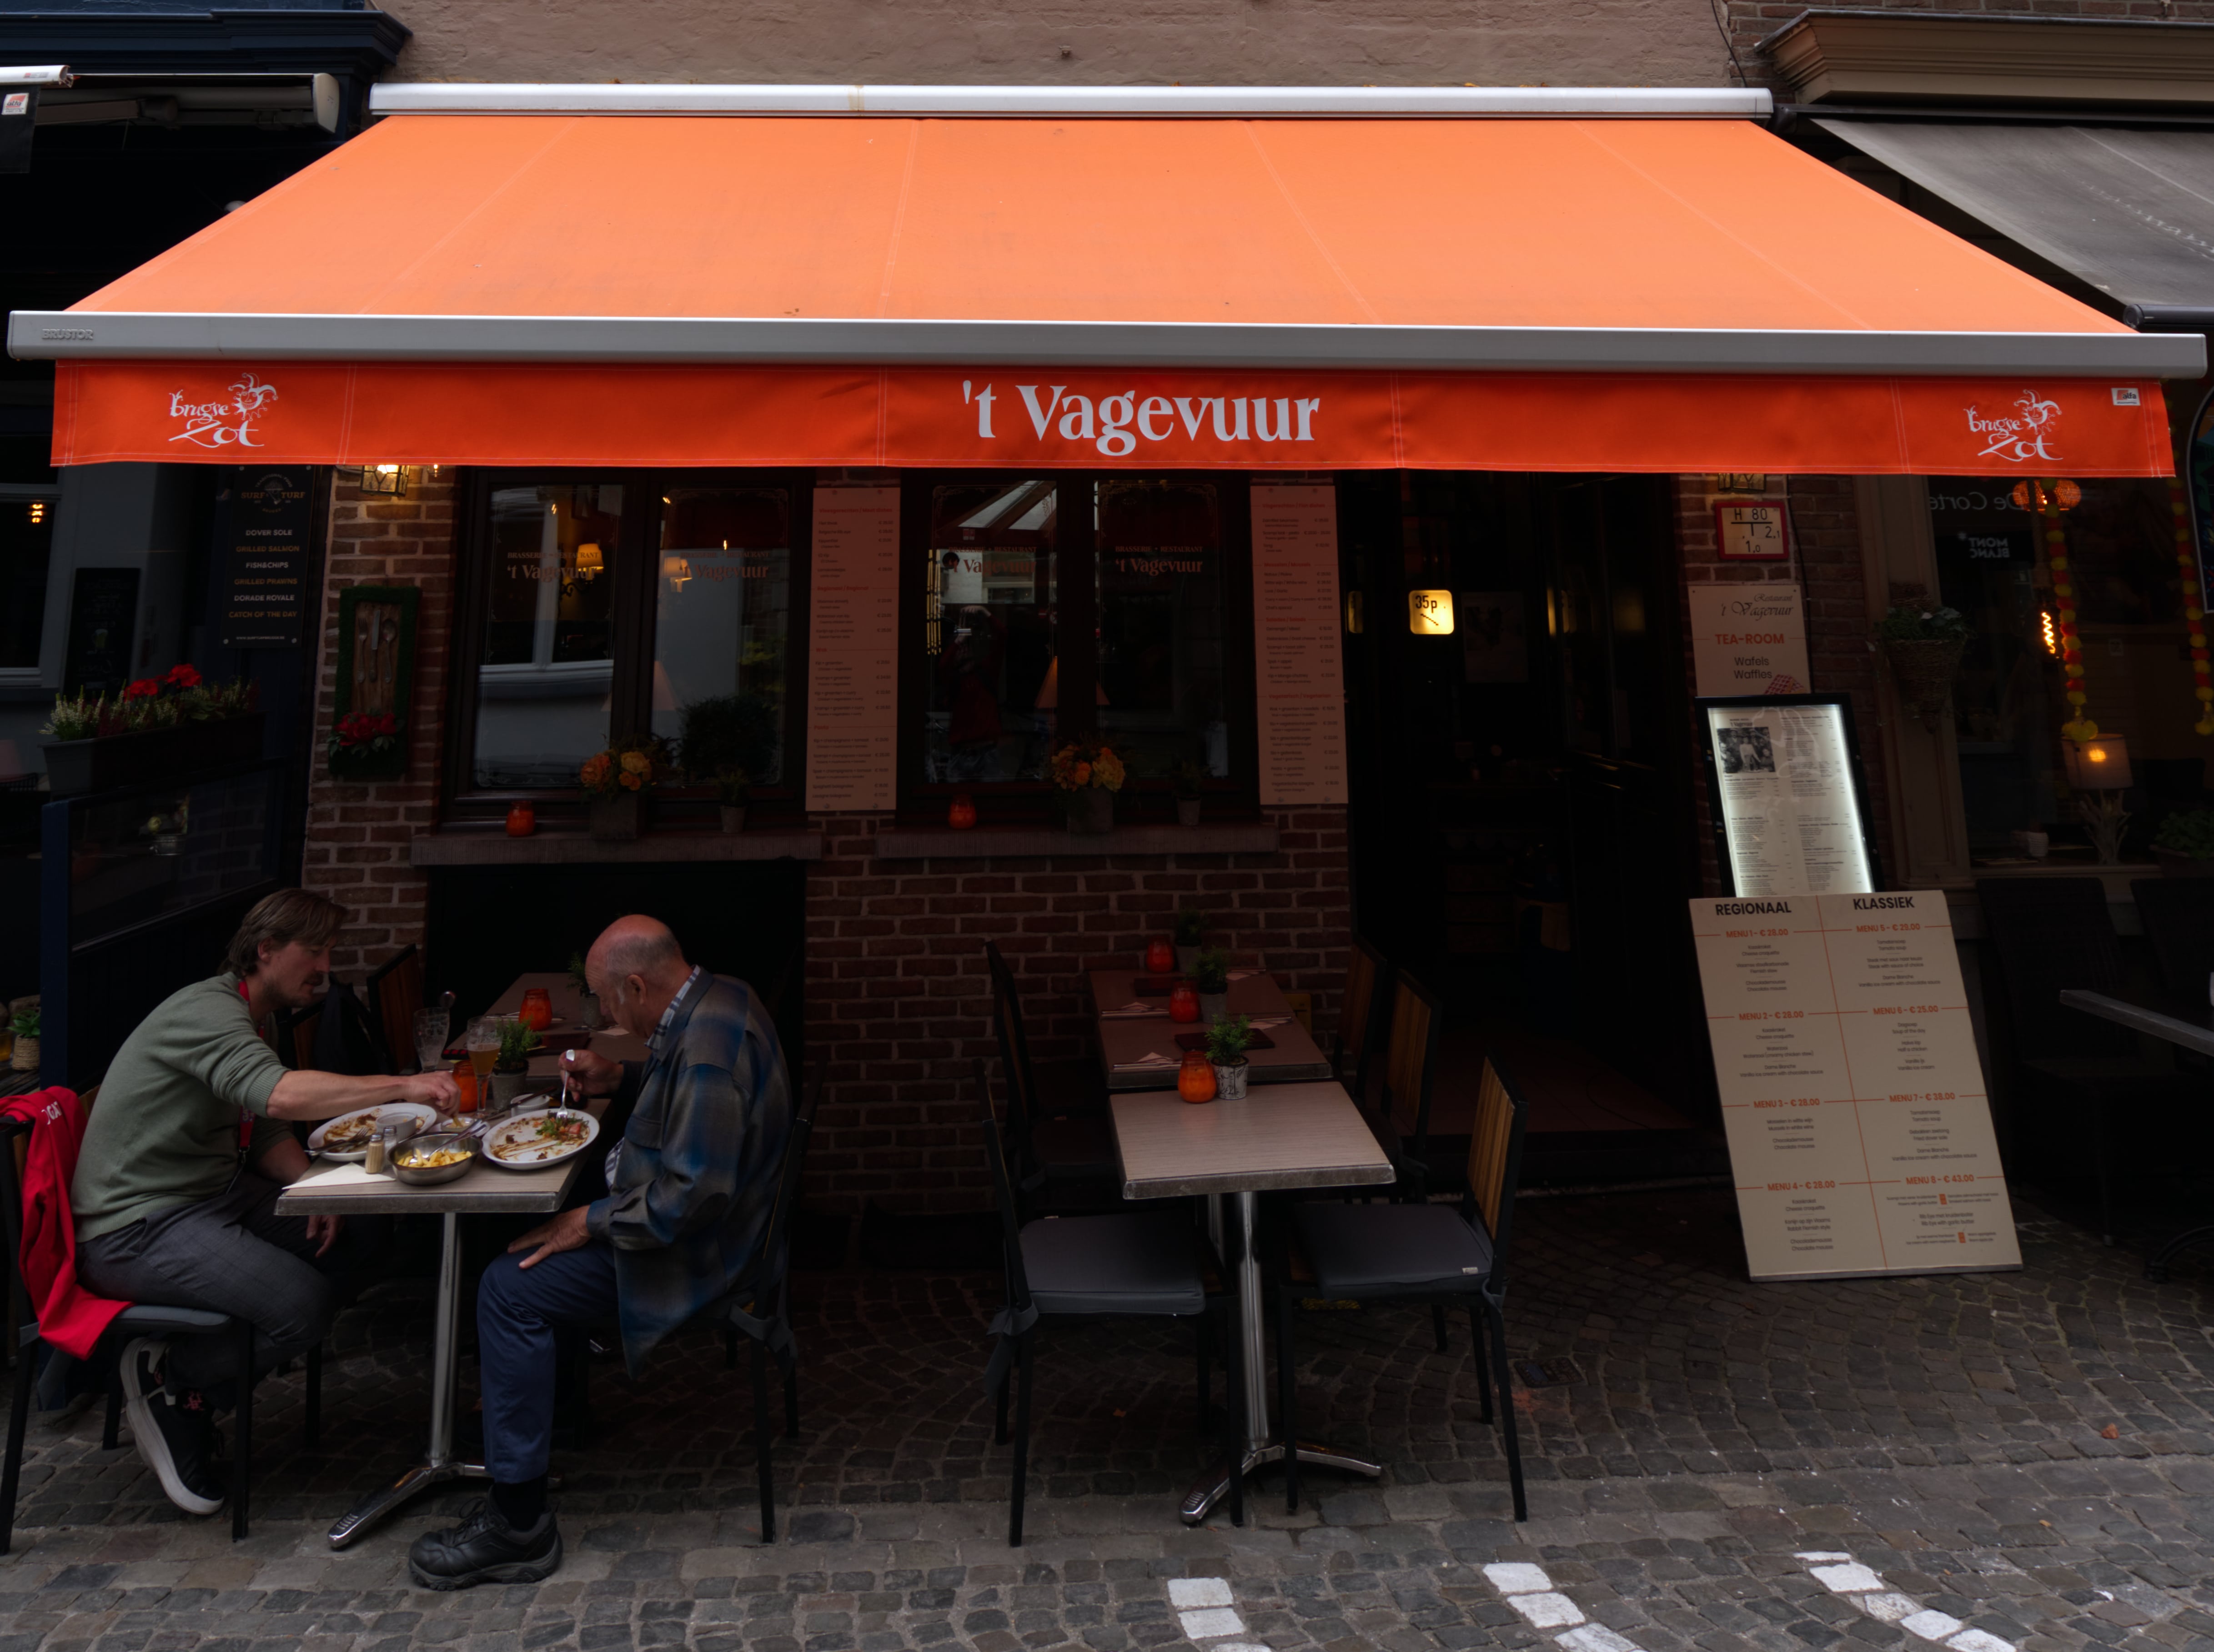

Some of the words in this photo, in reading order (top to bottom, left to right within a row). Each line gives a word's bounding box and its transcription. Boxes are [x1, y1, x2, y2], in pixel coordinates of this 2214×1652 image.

[42, 329, 93, 340] BRUSTOR
[169, 390, 231, 424] brugse
[963, 380, 997, 438] 't
[1015, 385, 1320, 456] Vagevuur
[1963, 405, 2023, 438] brugse
[1735, 509, 1742, 520] H
[1752, 509, 1767, 520] 80
[522, 565, 597, 582] Vagevuur
[695, 565, 769, 582] Vagevuur
[964, 560, 1036, 576] Vagevuur
[1130, 558, 1203, 576] Vagevuur
[1754, 593, 1792, 602] Restaurant
[1731, 601, 1793, 621] Vagevuur
[1715, 634, 1784, 645] TEA-ROOM
[1734, 656, 1769, 666] Wafels
[1734, 670, 1772, 679] Waffles
[1716, 902, 1792, 915] REGIONAAL
[1853, 896, 1915, 910] KLASSIEK
